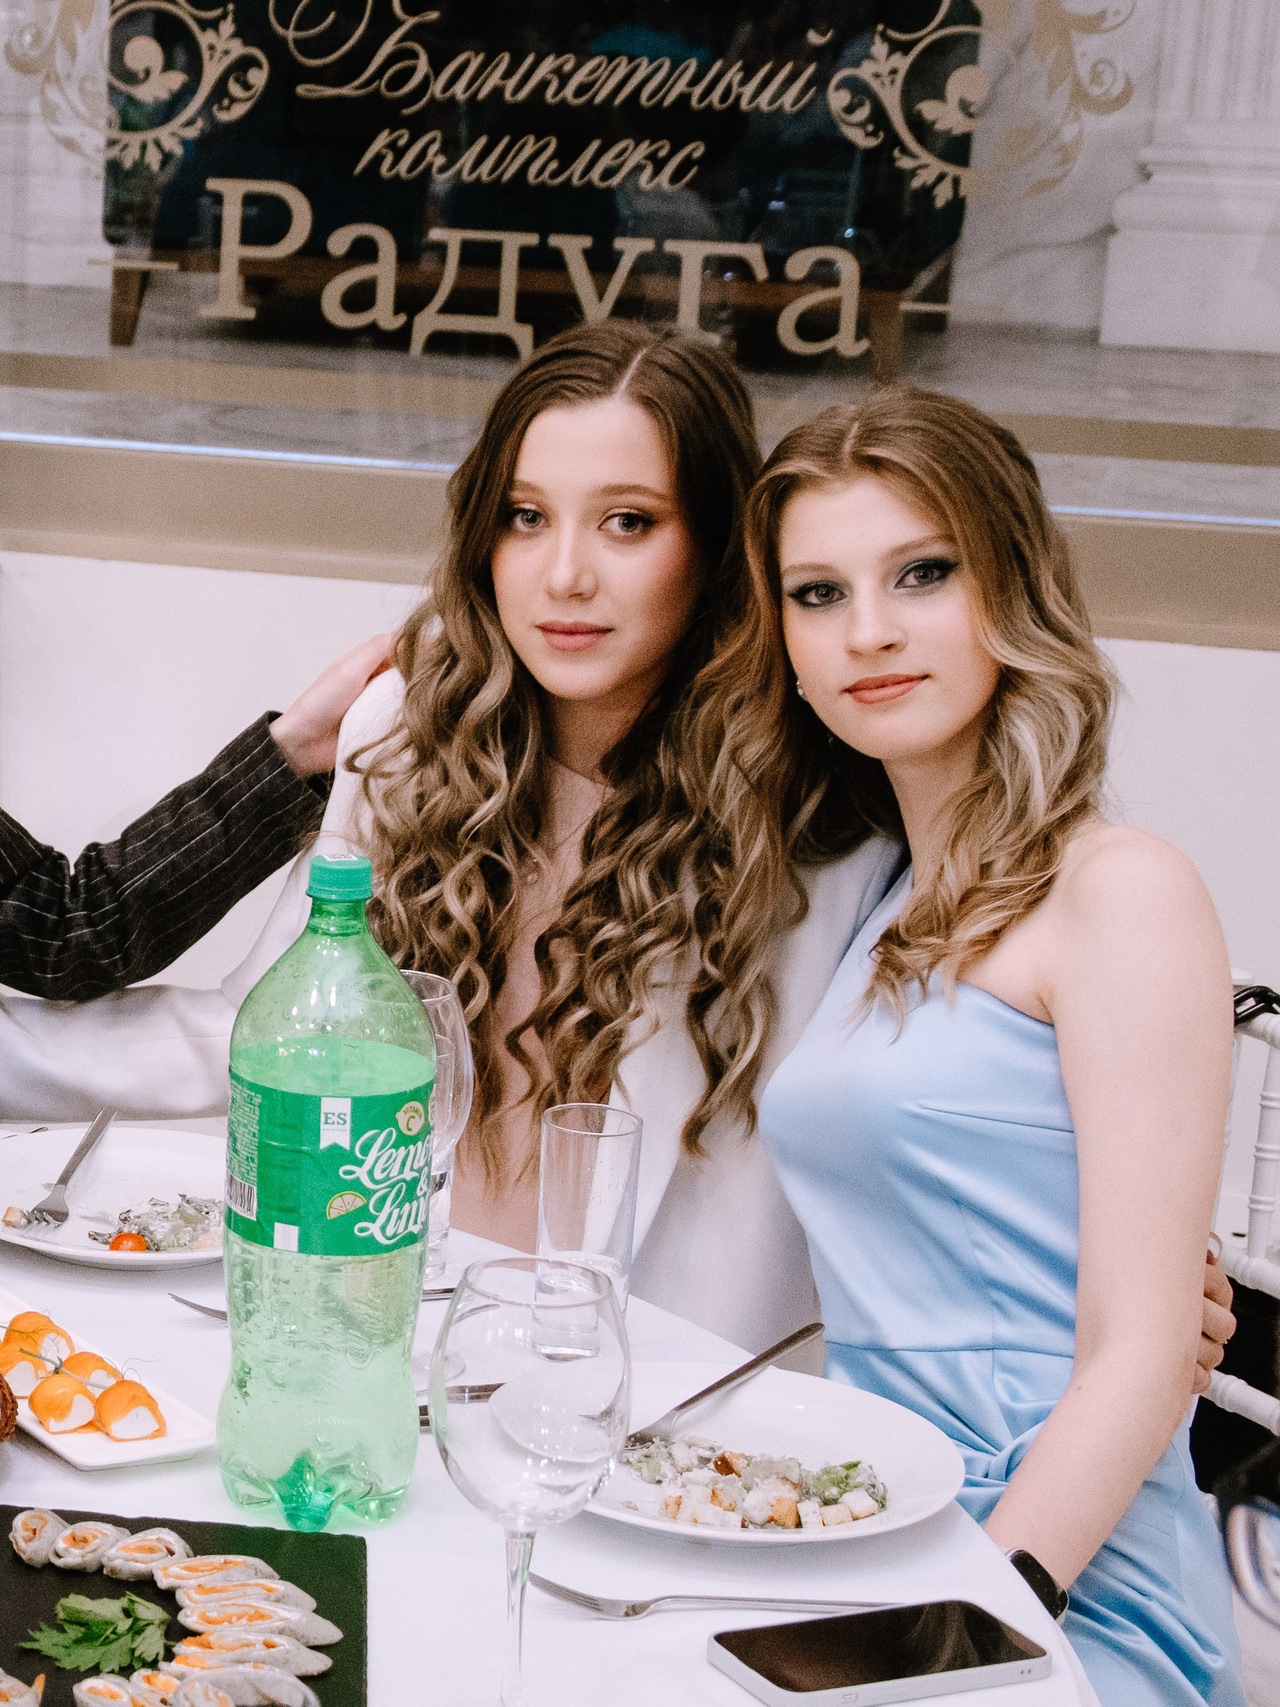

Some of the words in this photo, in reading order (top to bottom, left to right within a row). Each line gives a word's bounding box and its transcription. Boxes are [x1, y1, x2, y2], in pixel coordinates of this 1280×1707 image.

[269, 0, 833, 116] Банкетный
[353, 126, 707, 192] комплекс
[199, 177, 870, 358] Радуга
[322, 1112, 347, 1126] ES
